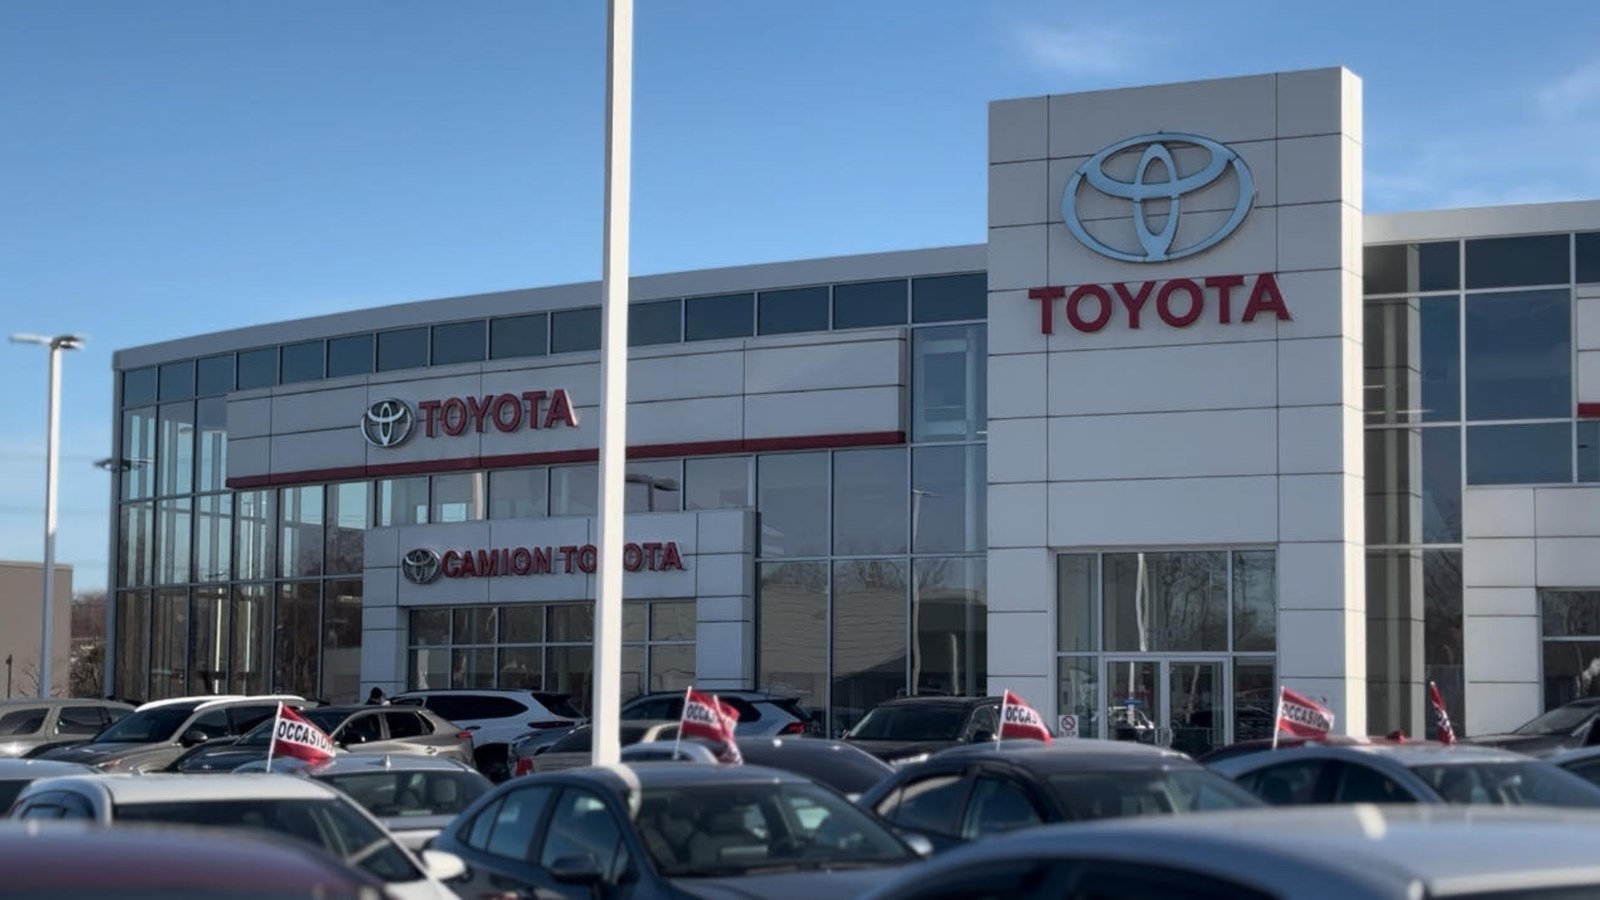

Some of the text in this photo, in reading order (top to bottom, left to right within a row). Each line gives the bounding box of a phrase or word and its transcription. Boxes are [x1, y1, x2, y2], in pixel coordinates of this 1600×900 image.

[1028, 272, 1291, 335] TOYOTA
[418, 389, 577, 438] TOYOTA
[441, 541, 684, 578] CAMION TOOTA
